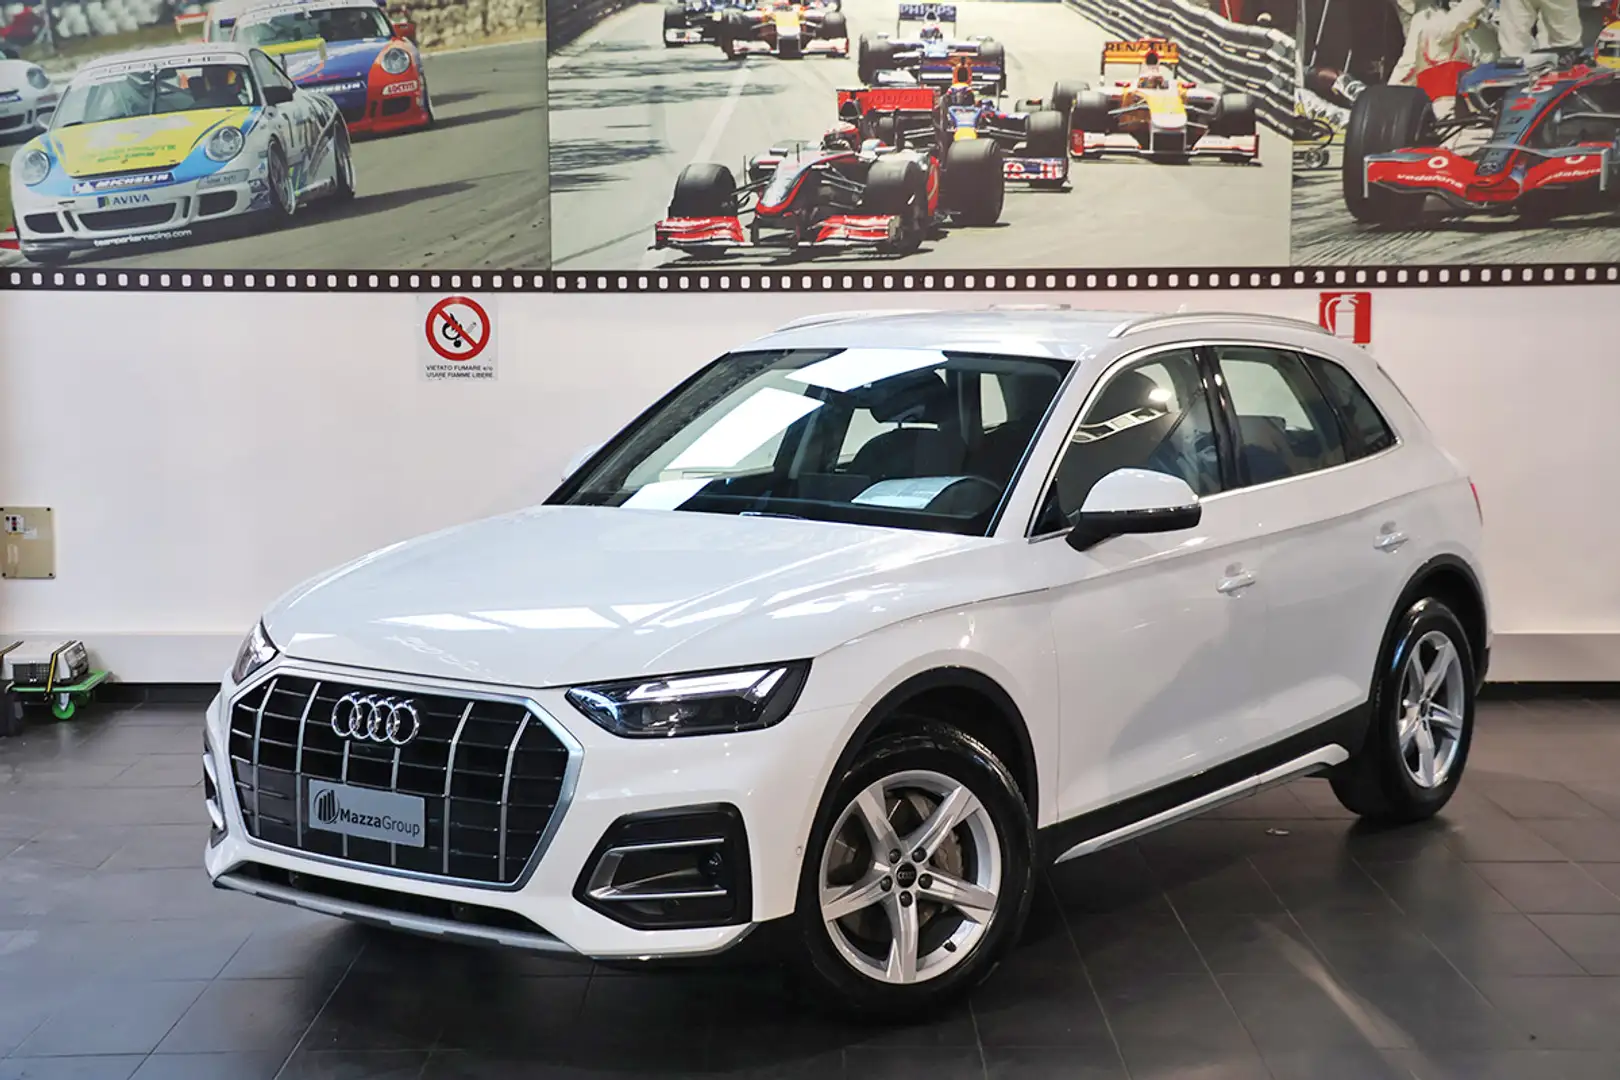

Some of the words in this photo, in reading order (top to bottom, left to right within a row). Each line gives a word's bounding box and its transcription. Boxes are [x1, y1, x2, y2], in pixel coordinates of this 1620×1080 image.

[95, 172, 169, 189] MICHELIN
[1396, 172, 1465, 189] vodafone
[112, 193, 151, 206] AVIVA
[340, 808, 420, 837] MazzaGroup
